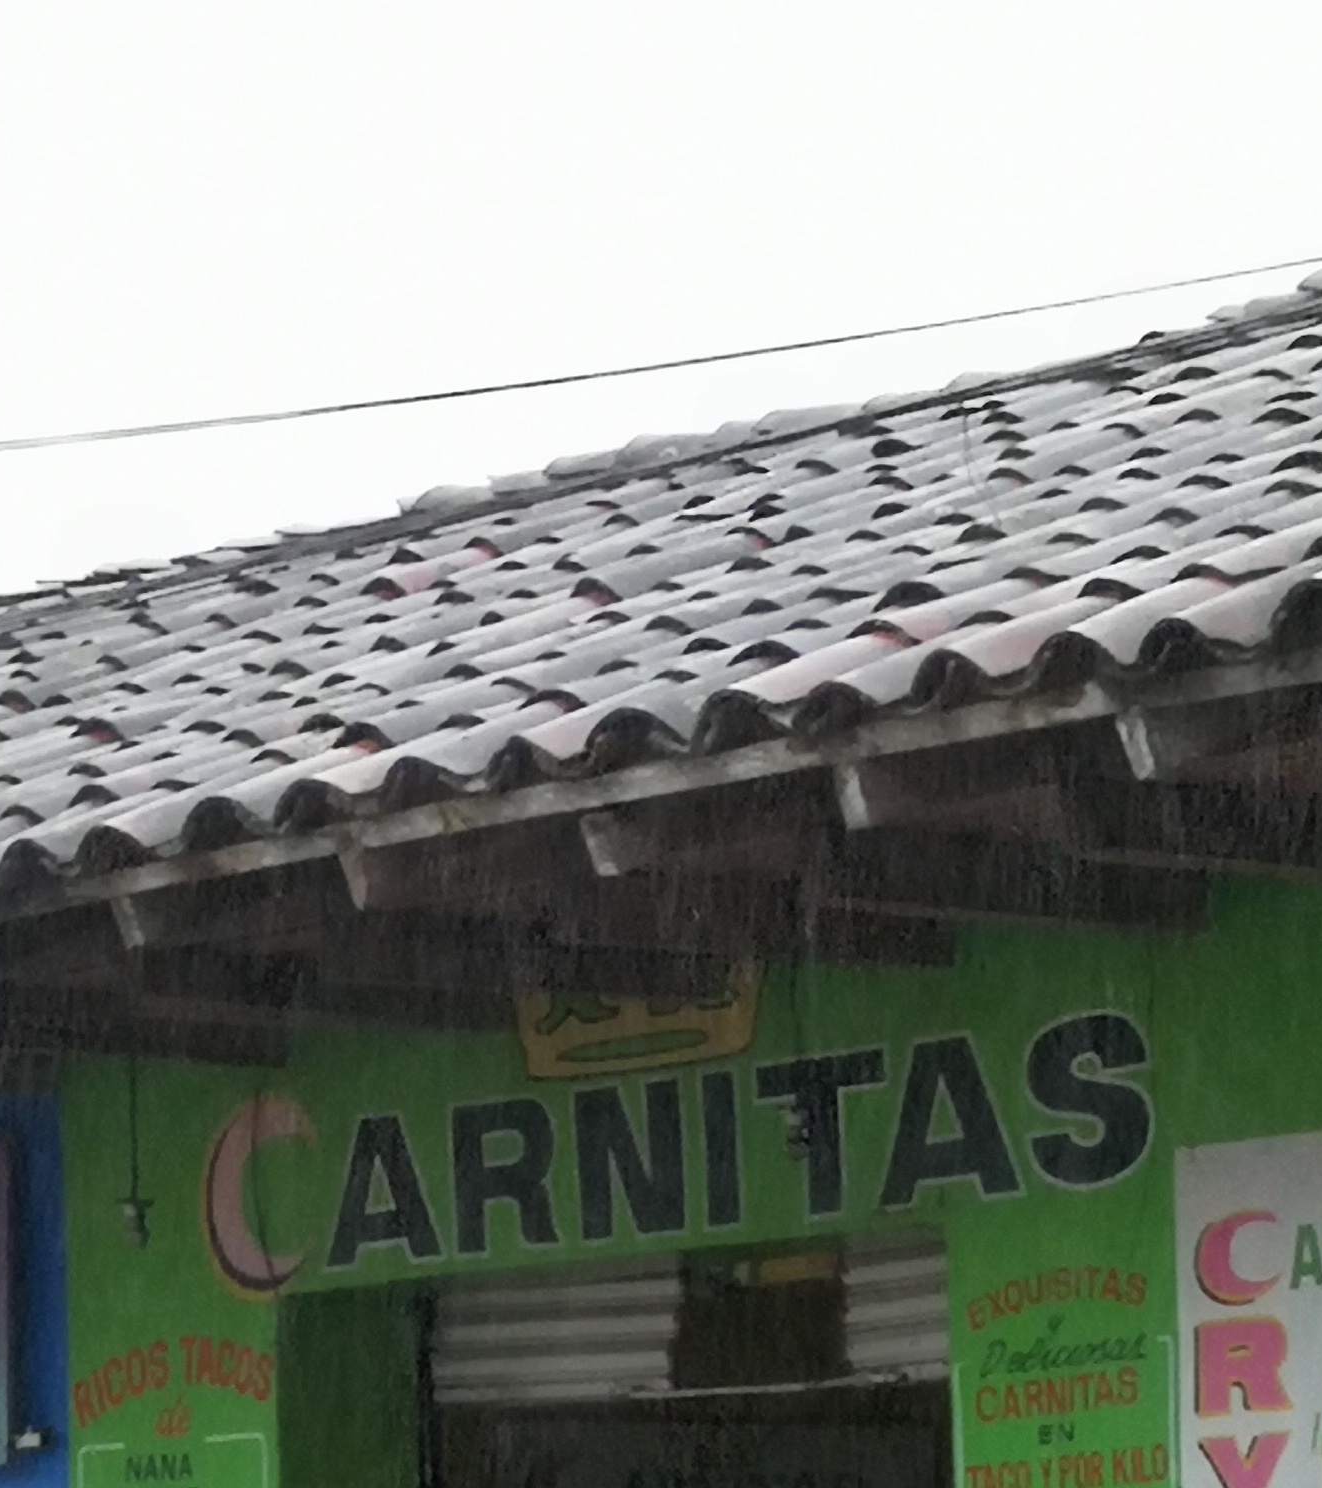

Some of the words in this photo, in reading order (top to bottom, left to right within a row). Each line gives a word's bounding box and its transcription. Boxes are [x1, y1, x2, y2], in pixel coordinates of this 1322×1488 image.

[201, 1008, 1154, 1302] CARNITAS
[966, 1264, 1148, 1332] EXQUISITAS
[72, 1339, 171, 1430] RICOS
[178, 1334, 277, 1404] TACOS
[975, 1366, 1139, 1424] CARNITAS
[154, 1395, 193, 1440] de
[1038, 1423, 1076, 1445] EN
[125, 1453, 193, 1483] NANA
[1112, 1443, 1169, 1486] KILO
